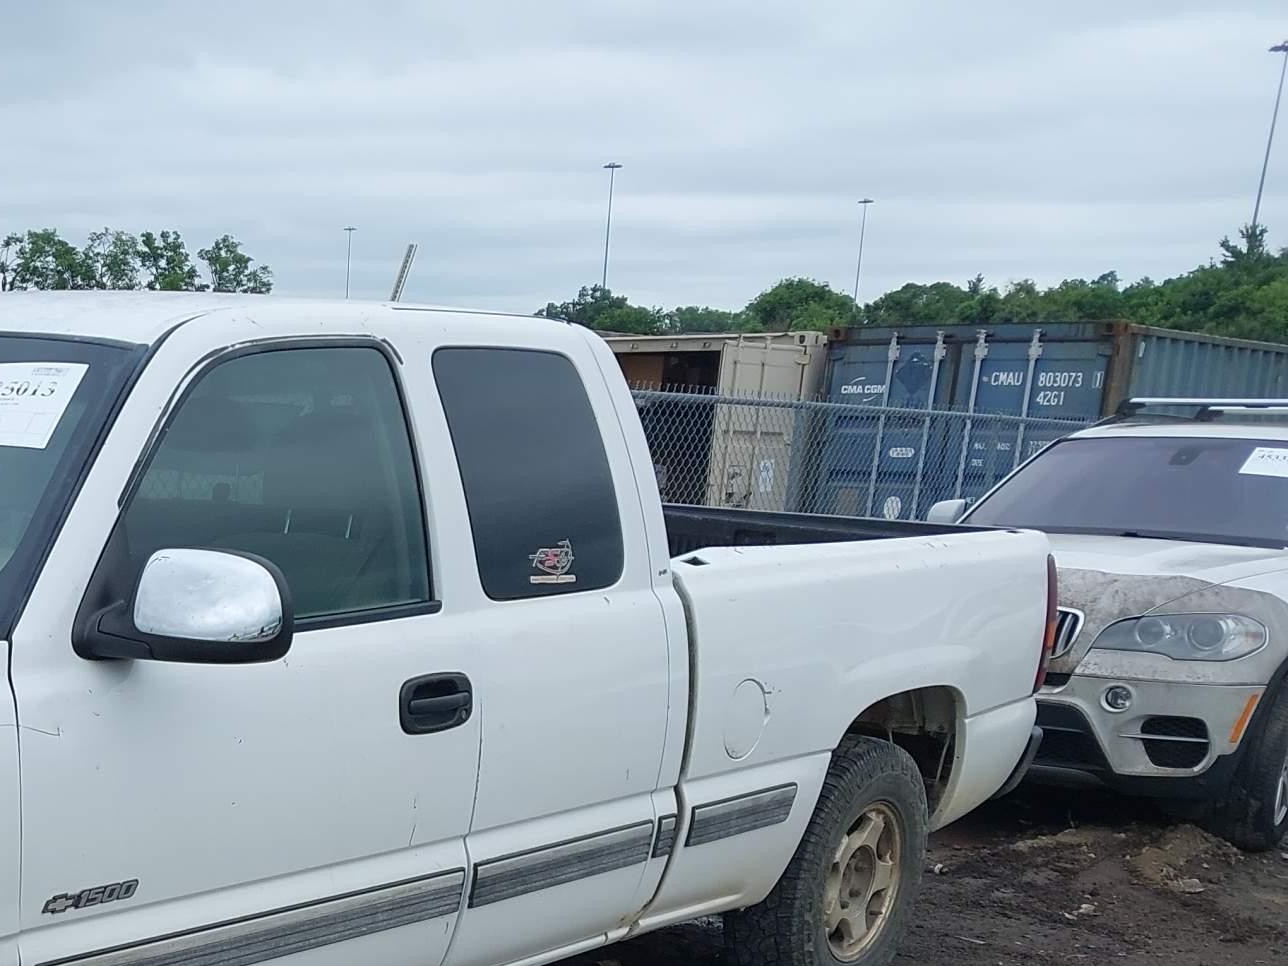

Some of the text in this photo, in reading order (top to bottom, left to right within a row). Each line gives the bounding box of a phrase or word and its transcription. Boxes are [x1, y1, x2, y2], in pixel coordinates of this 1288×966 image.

[991, 371, 1023, 386] CMAU
[1037, 372, 1083, 387] 803073
[840, 384, 886, 395] CMA CGM
[1036, 391, 1065, 406] 42G1
[75, 879, 139, 909] 1500
